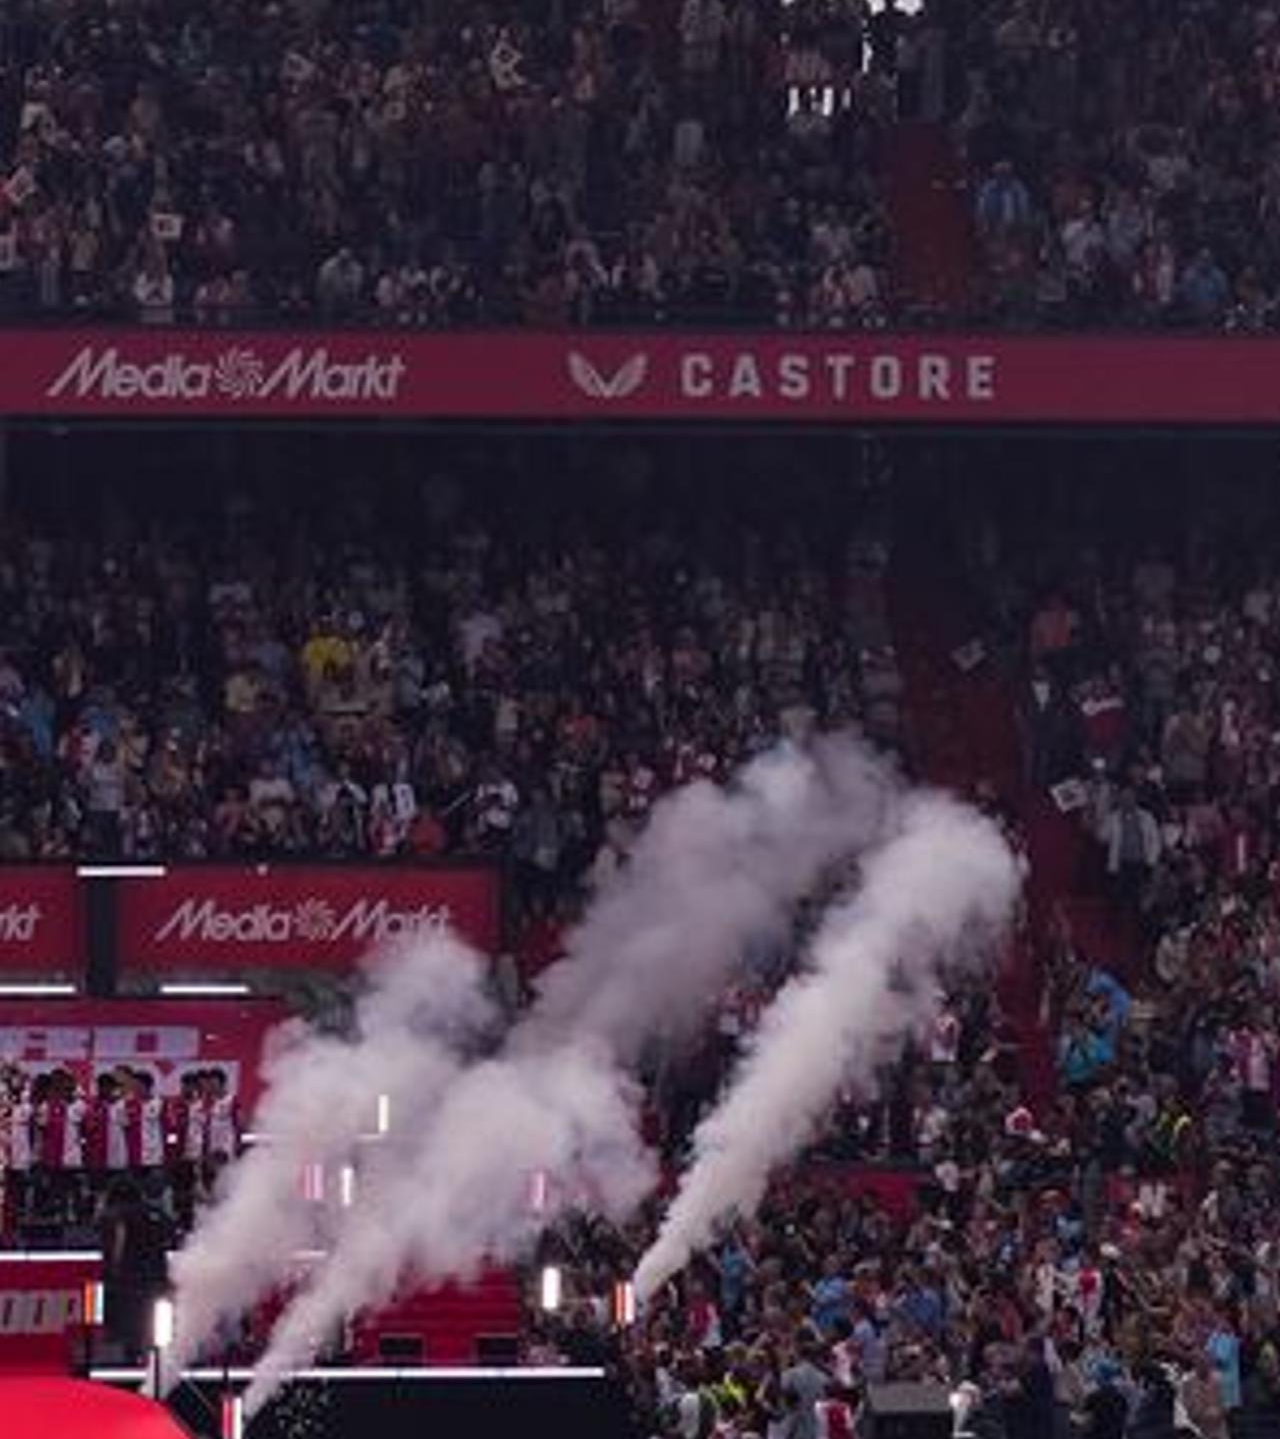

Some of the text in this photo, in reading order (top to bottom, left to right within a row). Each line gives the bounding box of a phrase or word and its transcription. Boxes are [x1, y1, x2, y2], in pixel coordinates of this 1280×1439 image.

[46, 347, 405, 398] Media Markt
[681, 354, 996, 399] CASTORE
[153, 897, 293, 942] Media
